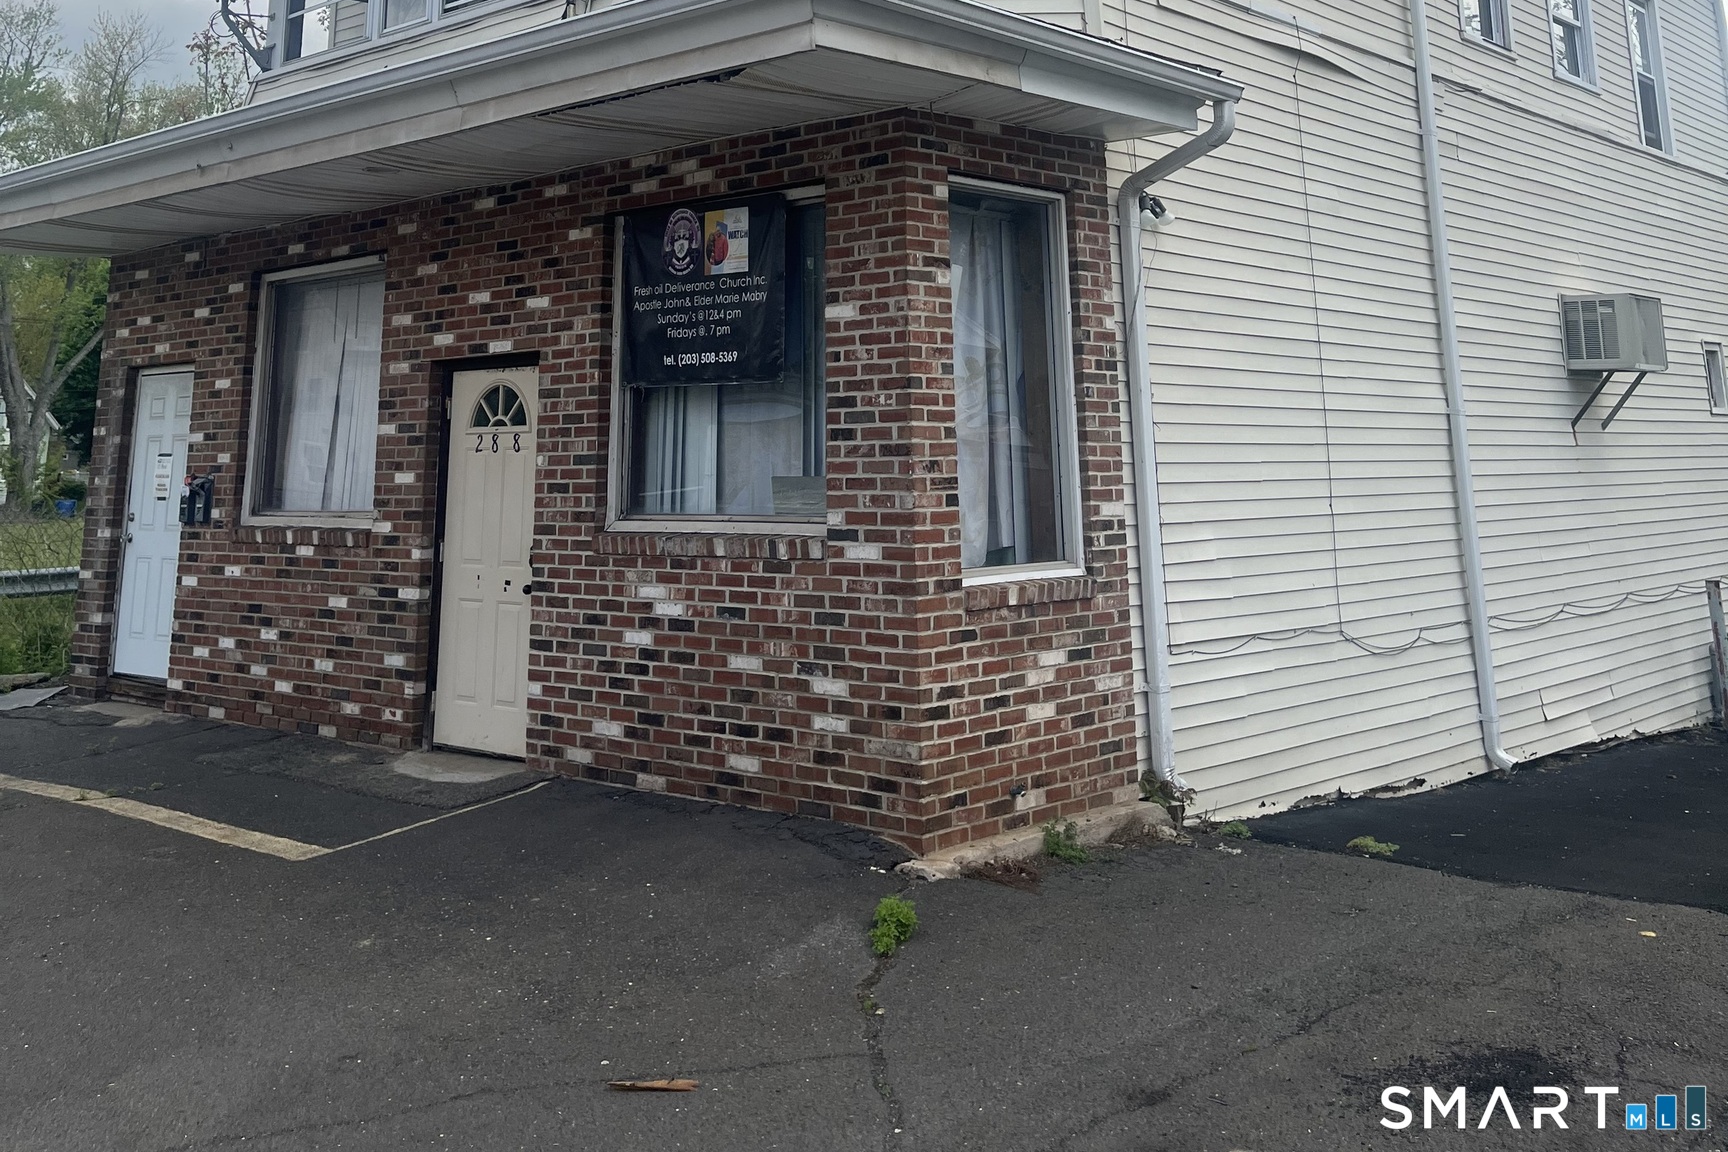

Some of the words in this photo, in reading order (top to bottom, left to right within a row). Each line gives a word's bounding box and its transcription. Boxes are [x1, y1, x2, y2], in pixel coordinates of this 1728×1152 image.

[634, 286, 653, 297] Fresh
[654, 284, 663, 295] oil
[665, 280, 715, 294] Deliverance
[719, 276, 752, 289] Church
[753, 275, 768, 286] Inc.
[633, 300, 662, 312] Apostle
[693, 294, 714, 306] Elder
[715, 292, 740, 304] Marie
[741, 290, 768, 303] Mabry
[657, 311, 696, 324] Sunday's
[726, 309, 742, 321] pm
[667, 327, 697, 339] Fridays
[710, 324, 715, 335] 7
[716, 325, 731, 337] pm
[663, 354, 676, 366] tel.
[678, 352, 700, 367] (203)
[701, 350, 738, 364] 508-5369
